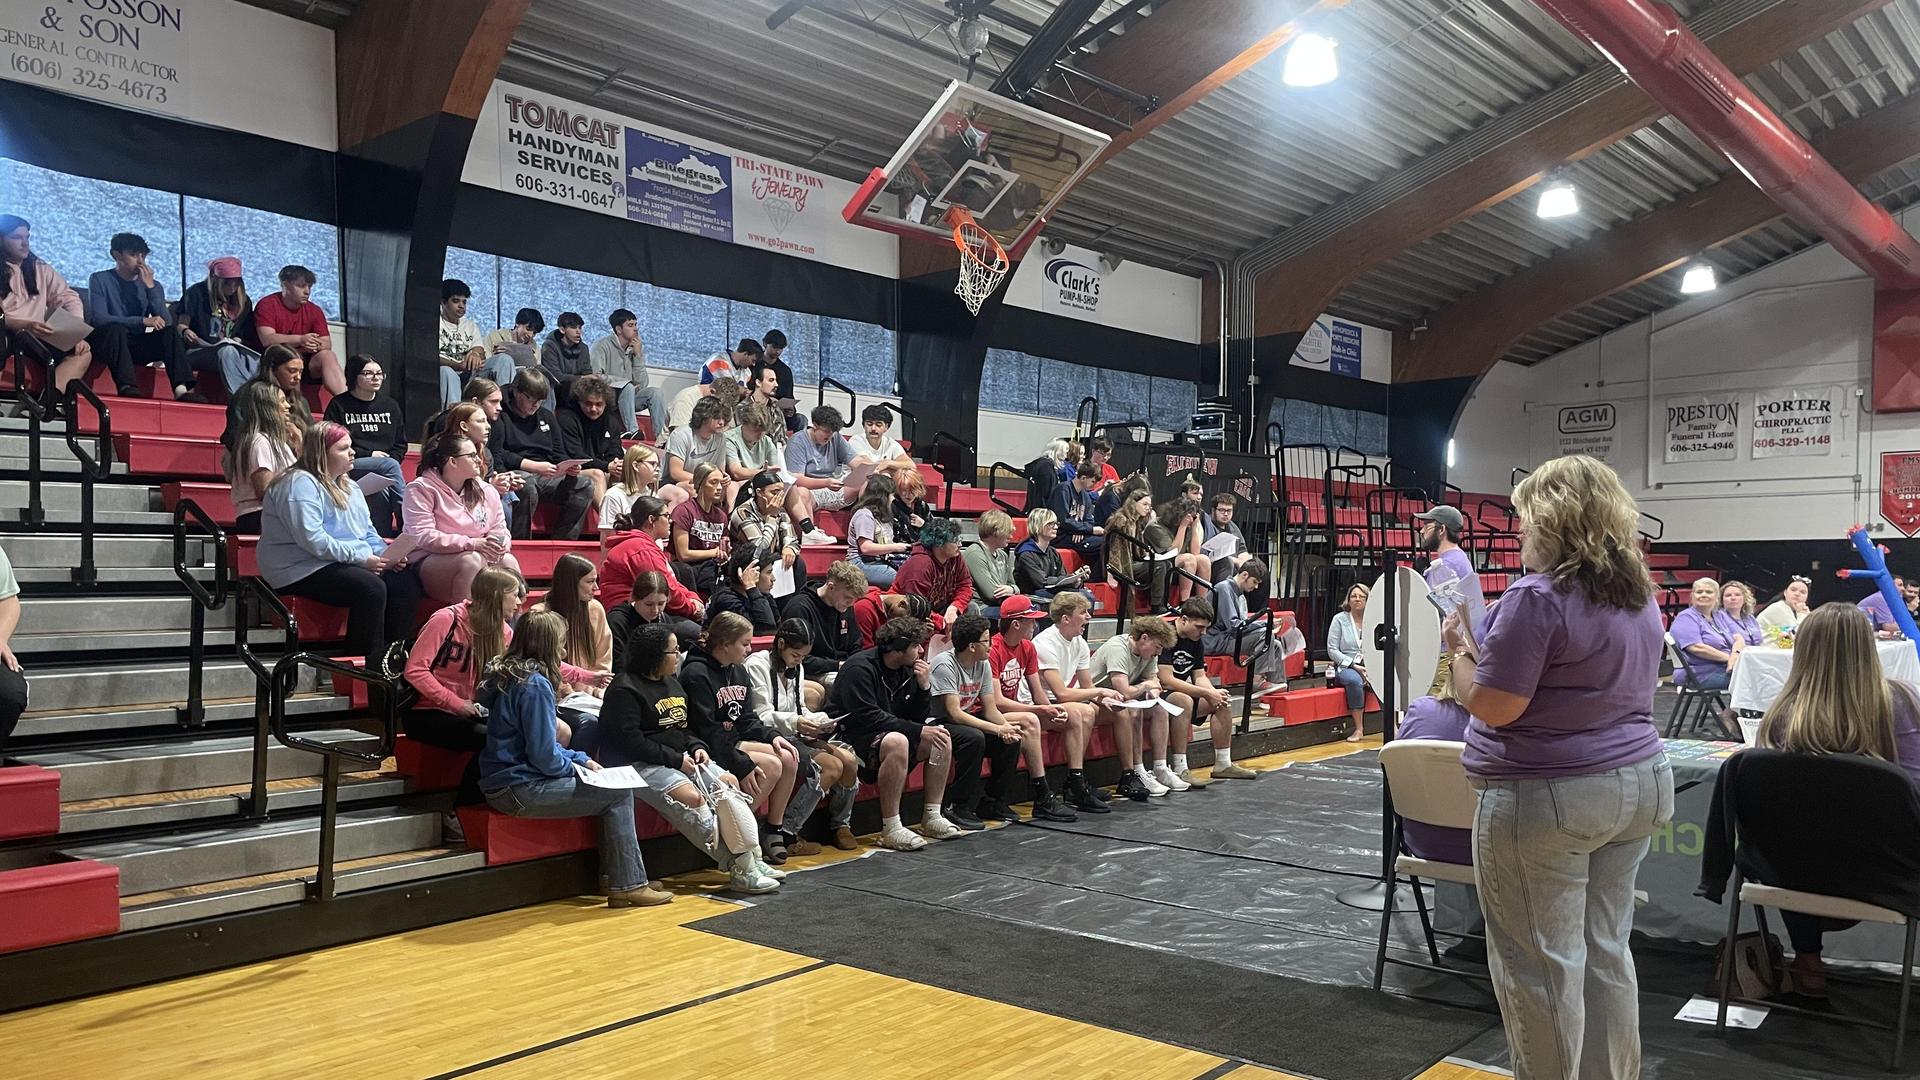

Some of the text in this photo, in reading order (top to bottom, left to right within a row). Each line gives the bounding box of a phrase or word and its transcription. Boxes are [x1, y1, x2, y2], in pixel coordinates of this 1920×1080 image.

[40, 6, 140, 50] & SON
[0, 28, 179, 83] GENERAL CONTRACTOR
[11, 52, 168, 104] (606) 325-4673
[505, 94, 620, 149] TOMCAT
[508, 128, 619, 170] HANDYMAN
[517, 150, 613, 186] SERVICES
[654, 158, 722, 184] Bluegrass
[734, 156, 824, 189] TRI-STATE PAWN
[515, 173, 616, 209] 606-331-0647
[756, 177, 809, 212] JEWELRY
[748, 233, 815, 254] www.go2pawn.com
[1061, 270, 1100, 296] Clark's
[1059, 289, 1099, 306] PUMP-N-SHOP
[345, 412, 392, 425] CARHARTT
[1565, 408, 1608, 424] AGM
[1667, 402, 1739, 433] PRESTON
[1756, 399, 1831, 417] PORTER
[360, 423, 379, 432] 1889
[1688, 423, 1717, 432] Family
[1754, 415, 1832, 429] CHIROPRACTIC
[1670, 441, 1735, 453] 606-325-4946
[1671, 430, 1734, 441] Funeral Home
[1754, 435, 1831, 449] 606-329-1148
